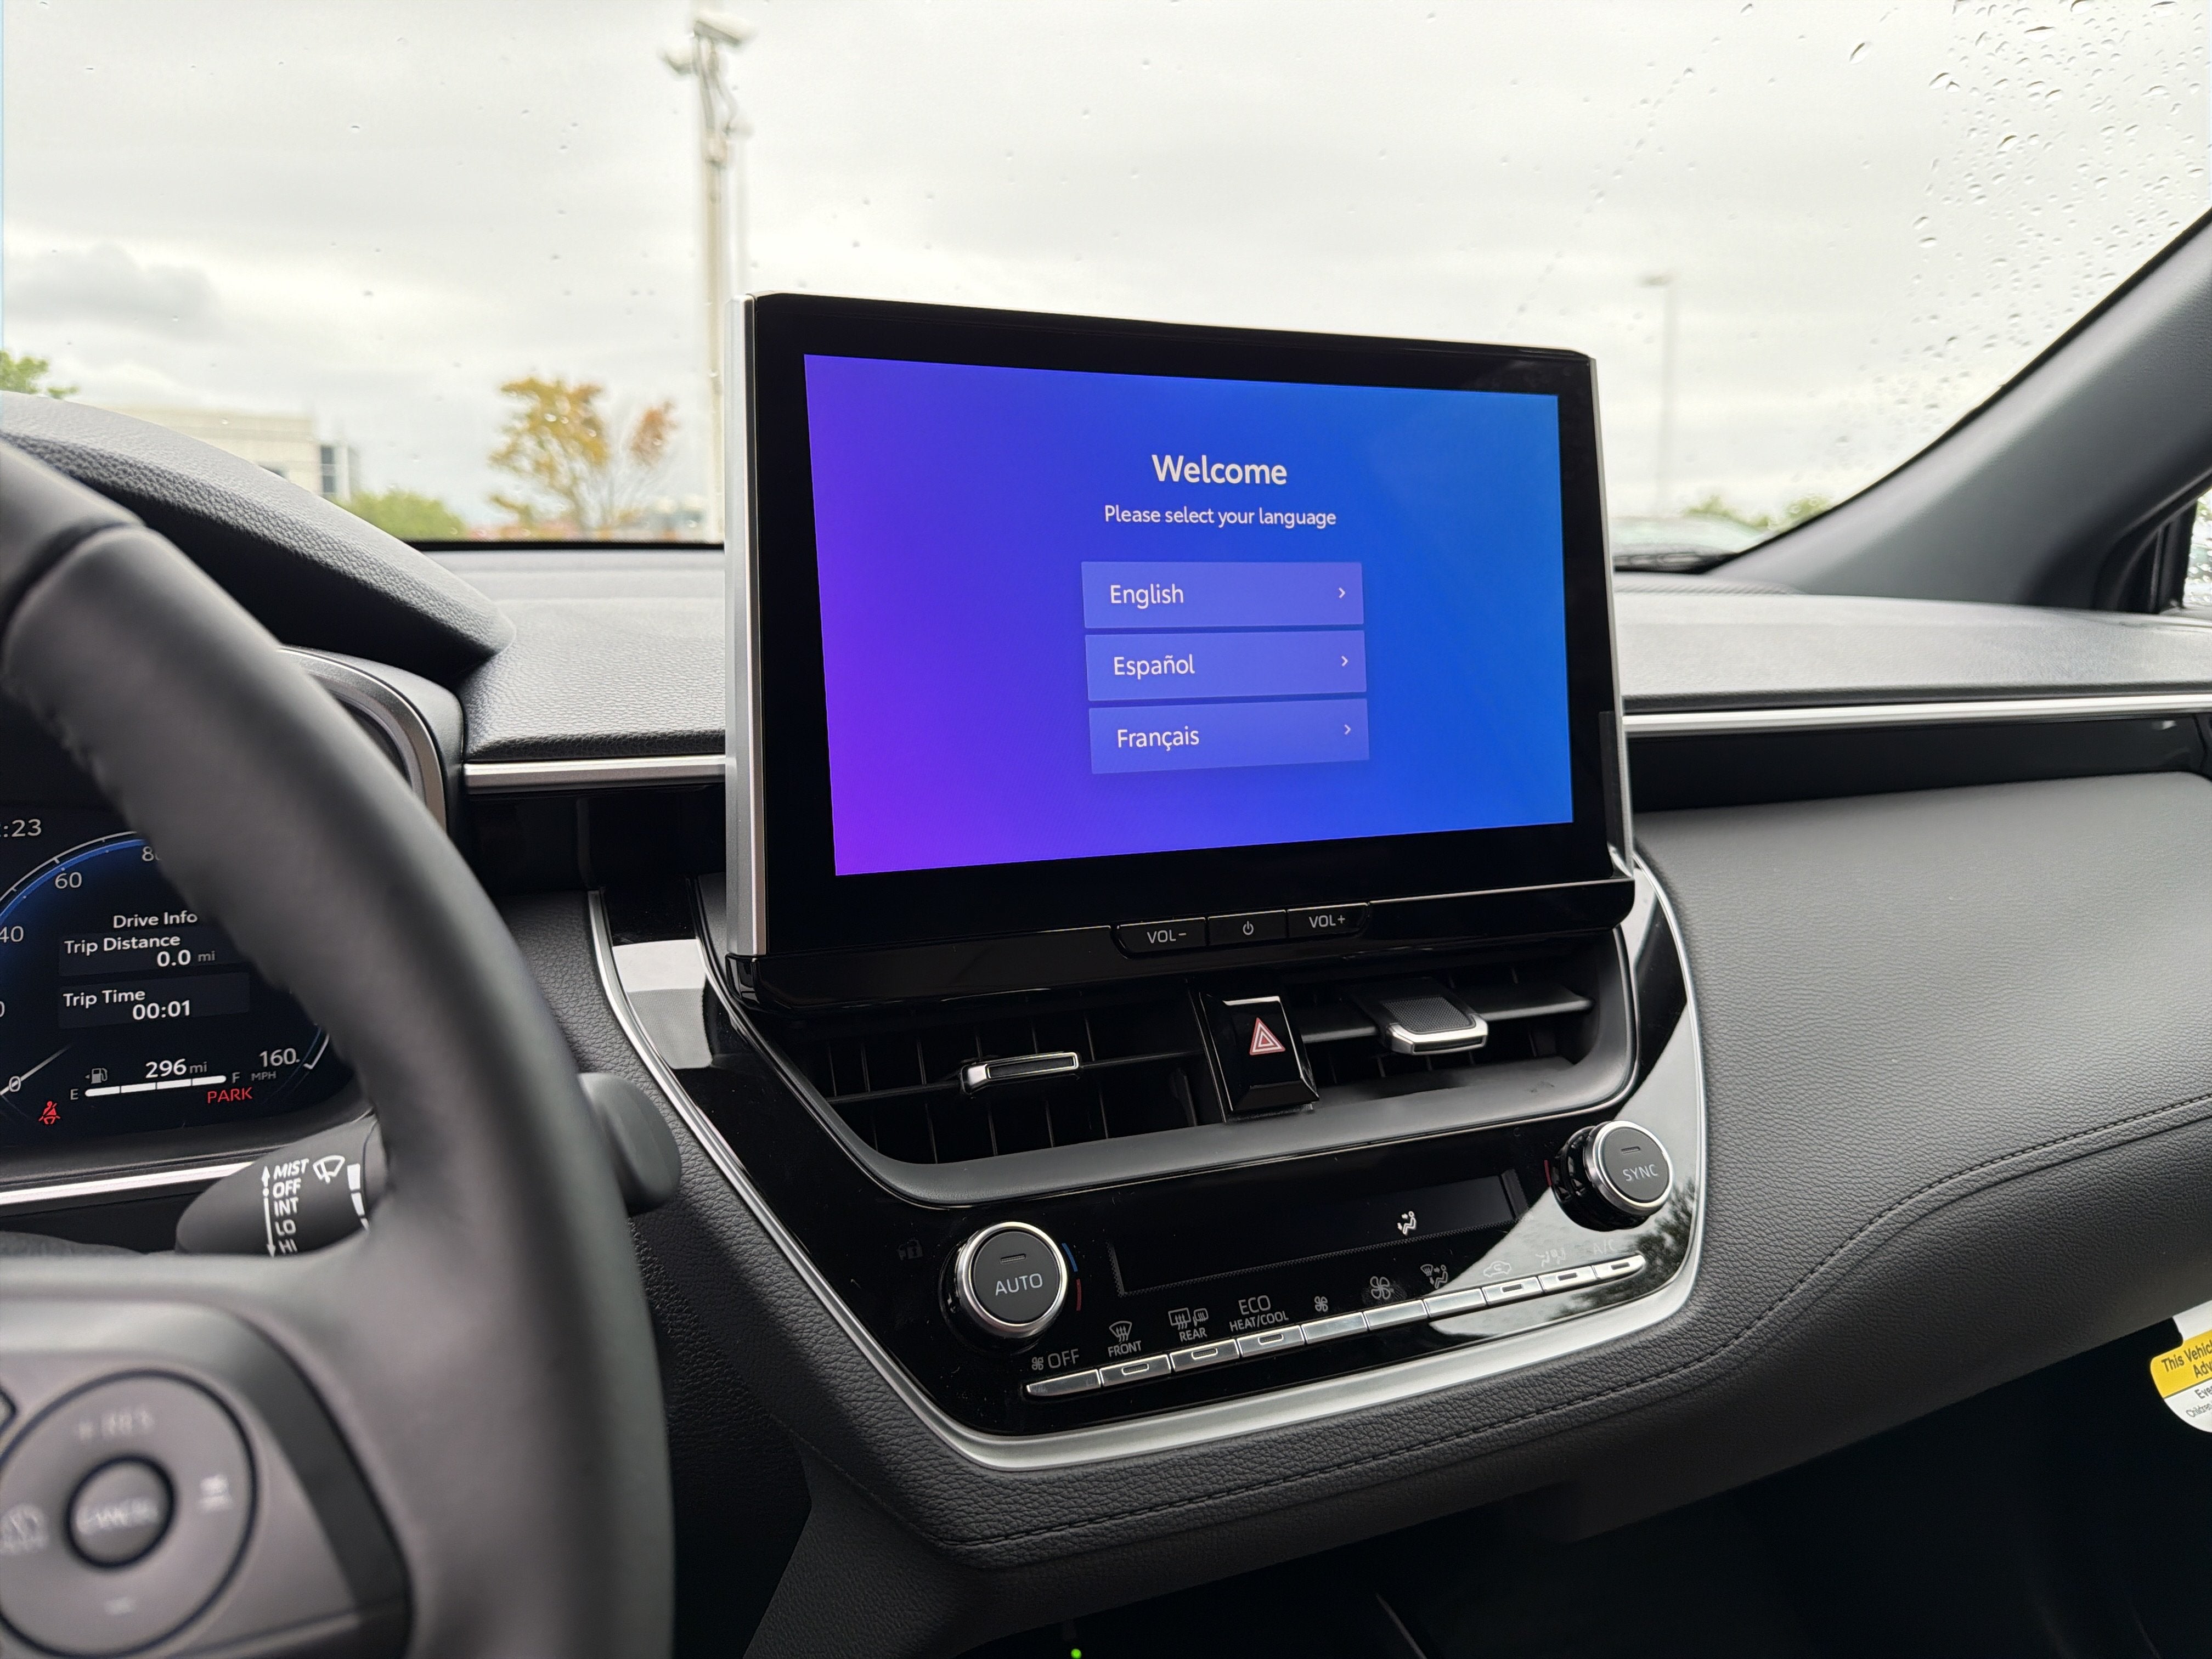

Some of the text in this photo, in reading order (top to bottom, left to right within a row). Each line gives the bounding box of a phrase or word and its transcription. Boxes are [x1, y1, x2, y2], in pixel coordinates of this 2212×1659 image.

[1152, 454, 1287, 485] Welcome
[1105, 504, 1336, 529] Please select your language
[1110, 583, 1184, 610] English
[1114, 653, 1195, 680] Español
[1118, 725, 1199, 752] Français
[0, 819, 42, 838] :23
[54, 871, 82, 889] 60
[113, 910, 198, 928] Drive Info
[0, 926, 24, 943] 40
[64, 934, 181, 956] Trip Distance
[157, 949, 215, 967] 0.0 mi
[63, 989, 145, 1009] Trip Time
[132, 1000, 191, 1020] 00:01
[259, 1048, 296, 1067] 160
[145, 1058, 207, 1079] 296 mi
[232, 1071, 240, 1084] F
[251, 1070, 276, 1082] MPH
[8, 1076, 21, 1092] 0
[70, 1088, 78, 1101] E
[207, 1087, 253, 1104] PARK
[273, 1158, 309, 1180] MIST
[1622, 1164, 1658, 1181] SYNC
[272, 1177, 302, 1199] OFF
[274, 1197, 299, 1217] INT
[275, 1219, 296, 1236] LO
[278, 1238, 299, 1254] HI
[995, 1273, 1043, 1296] AUTO
[1238, 1295, 1272, 1316] ECO
[1229, 1310, 1289, 1333] HEAT/COOL
[1178, 1327, 1208, 1343] REAR
[1108, 1339, 1142, 1357] FRONT
[1047, 1348, 1079, 1369] OFF
[2161, 1354, 2185, 1372] This
[2194, 1386, 2212, 1399] Eve
